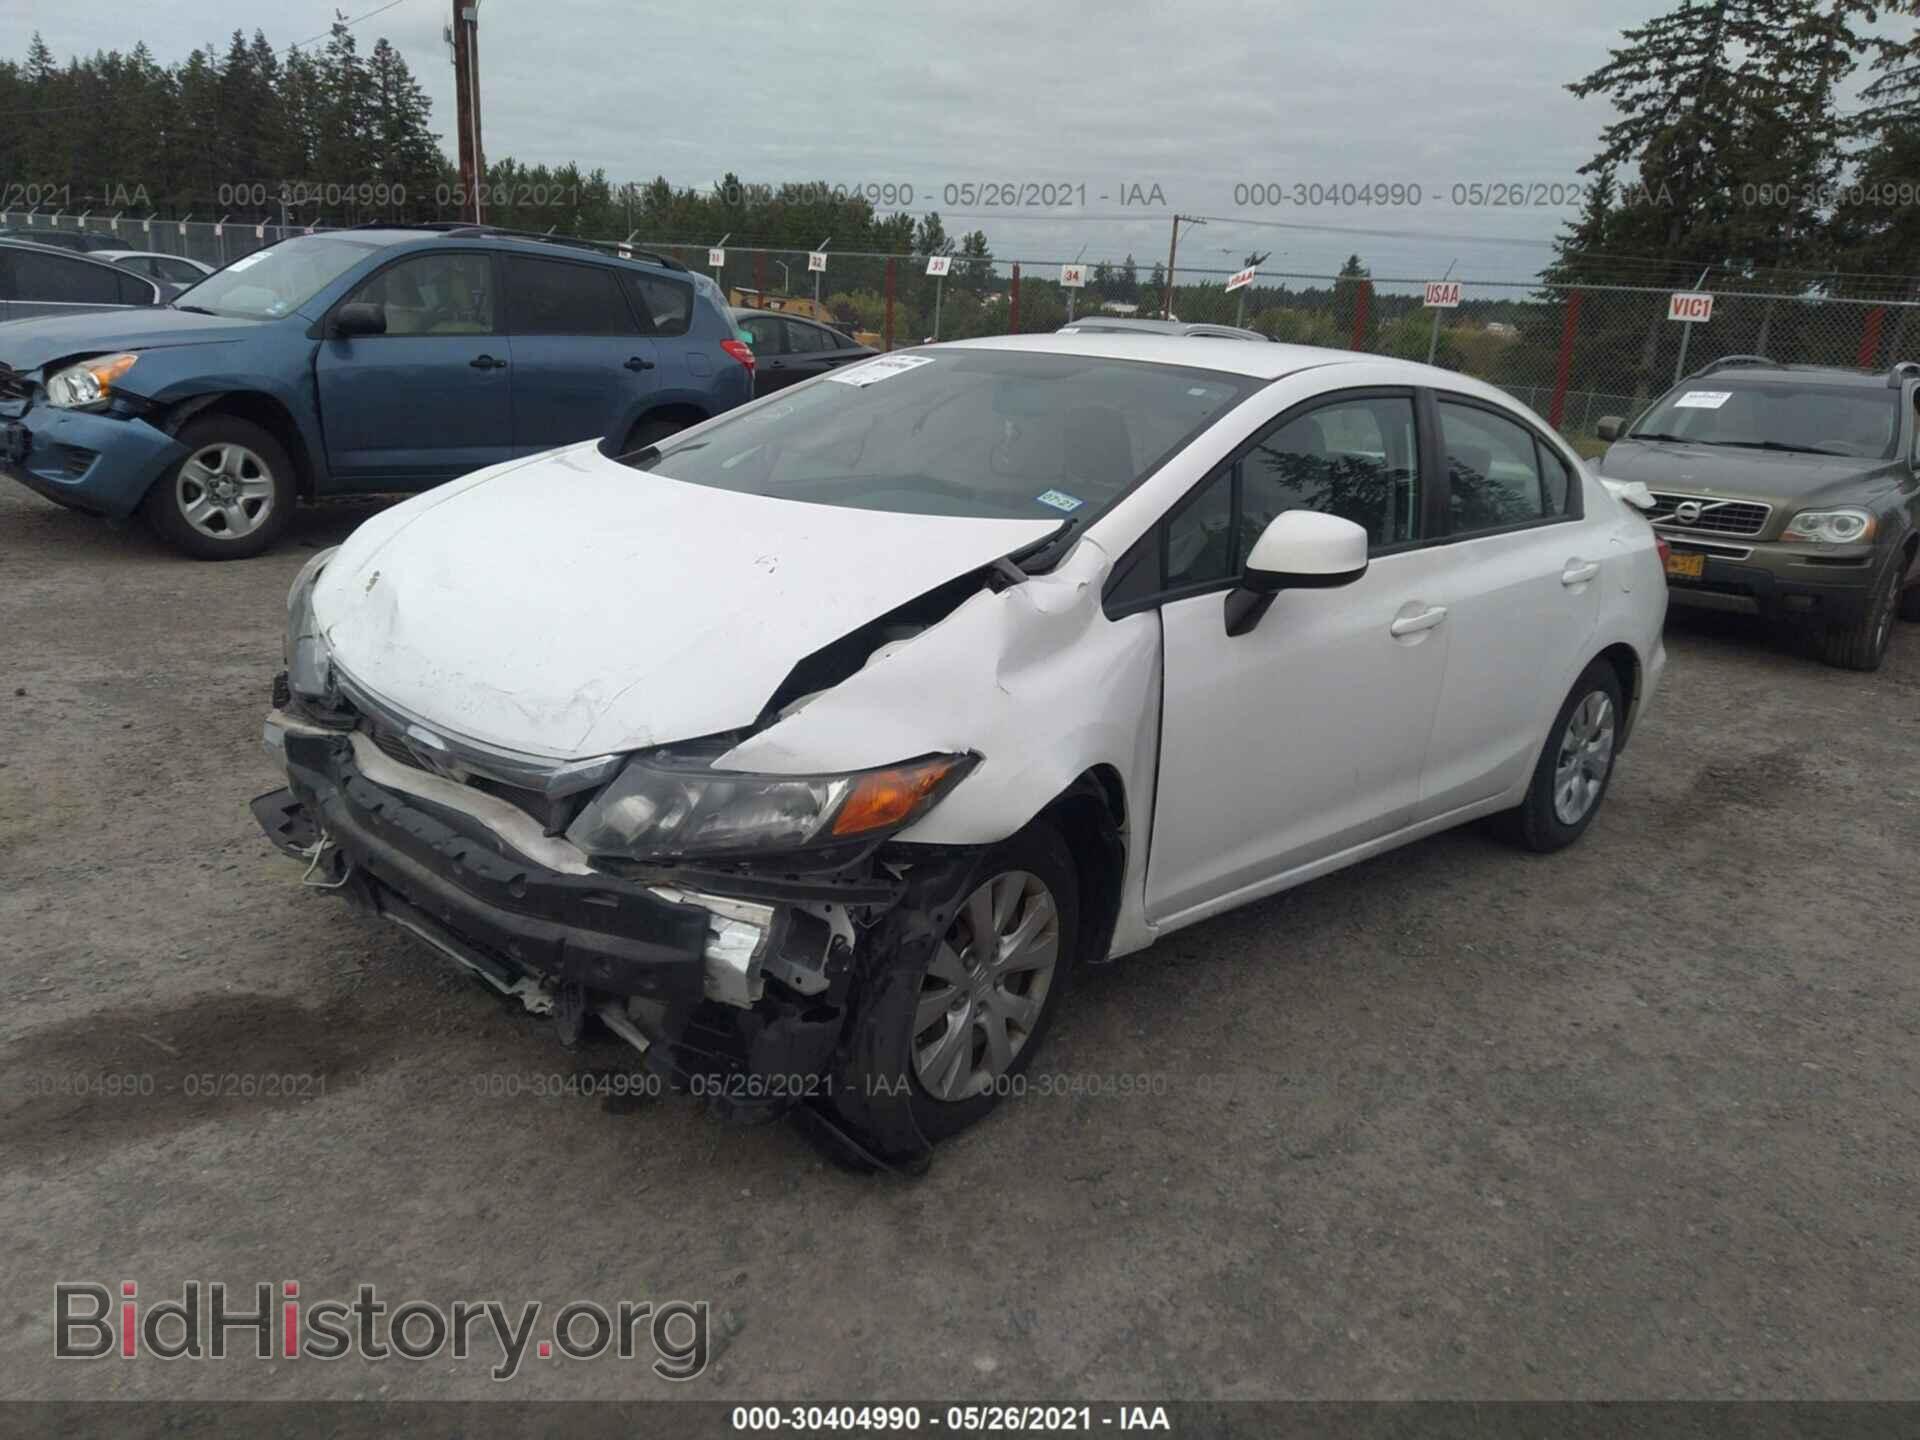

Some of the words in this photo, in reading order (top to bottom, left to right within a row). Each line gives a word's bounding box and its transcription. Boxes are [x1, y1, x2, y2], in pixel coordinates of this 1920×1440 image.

[931, 261, 944, 272] 33
[1065, 270, 1079, 282] 34
[1426, 284, 1460, 305] USAA
